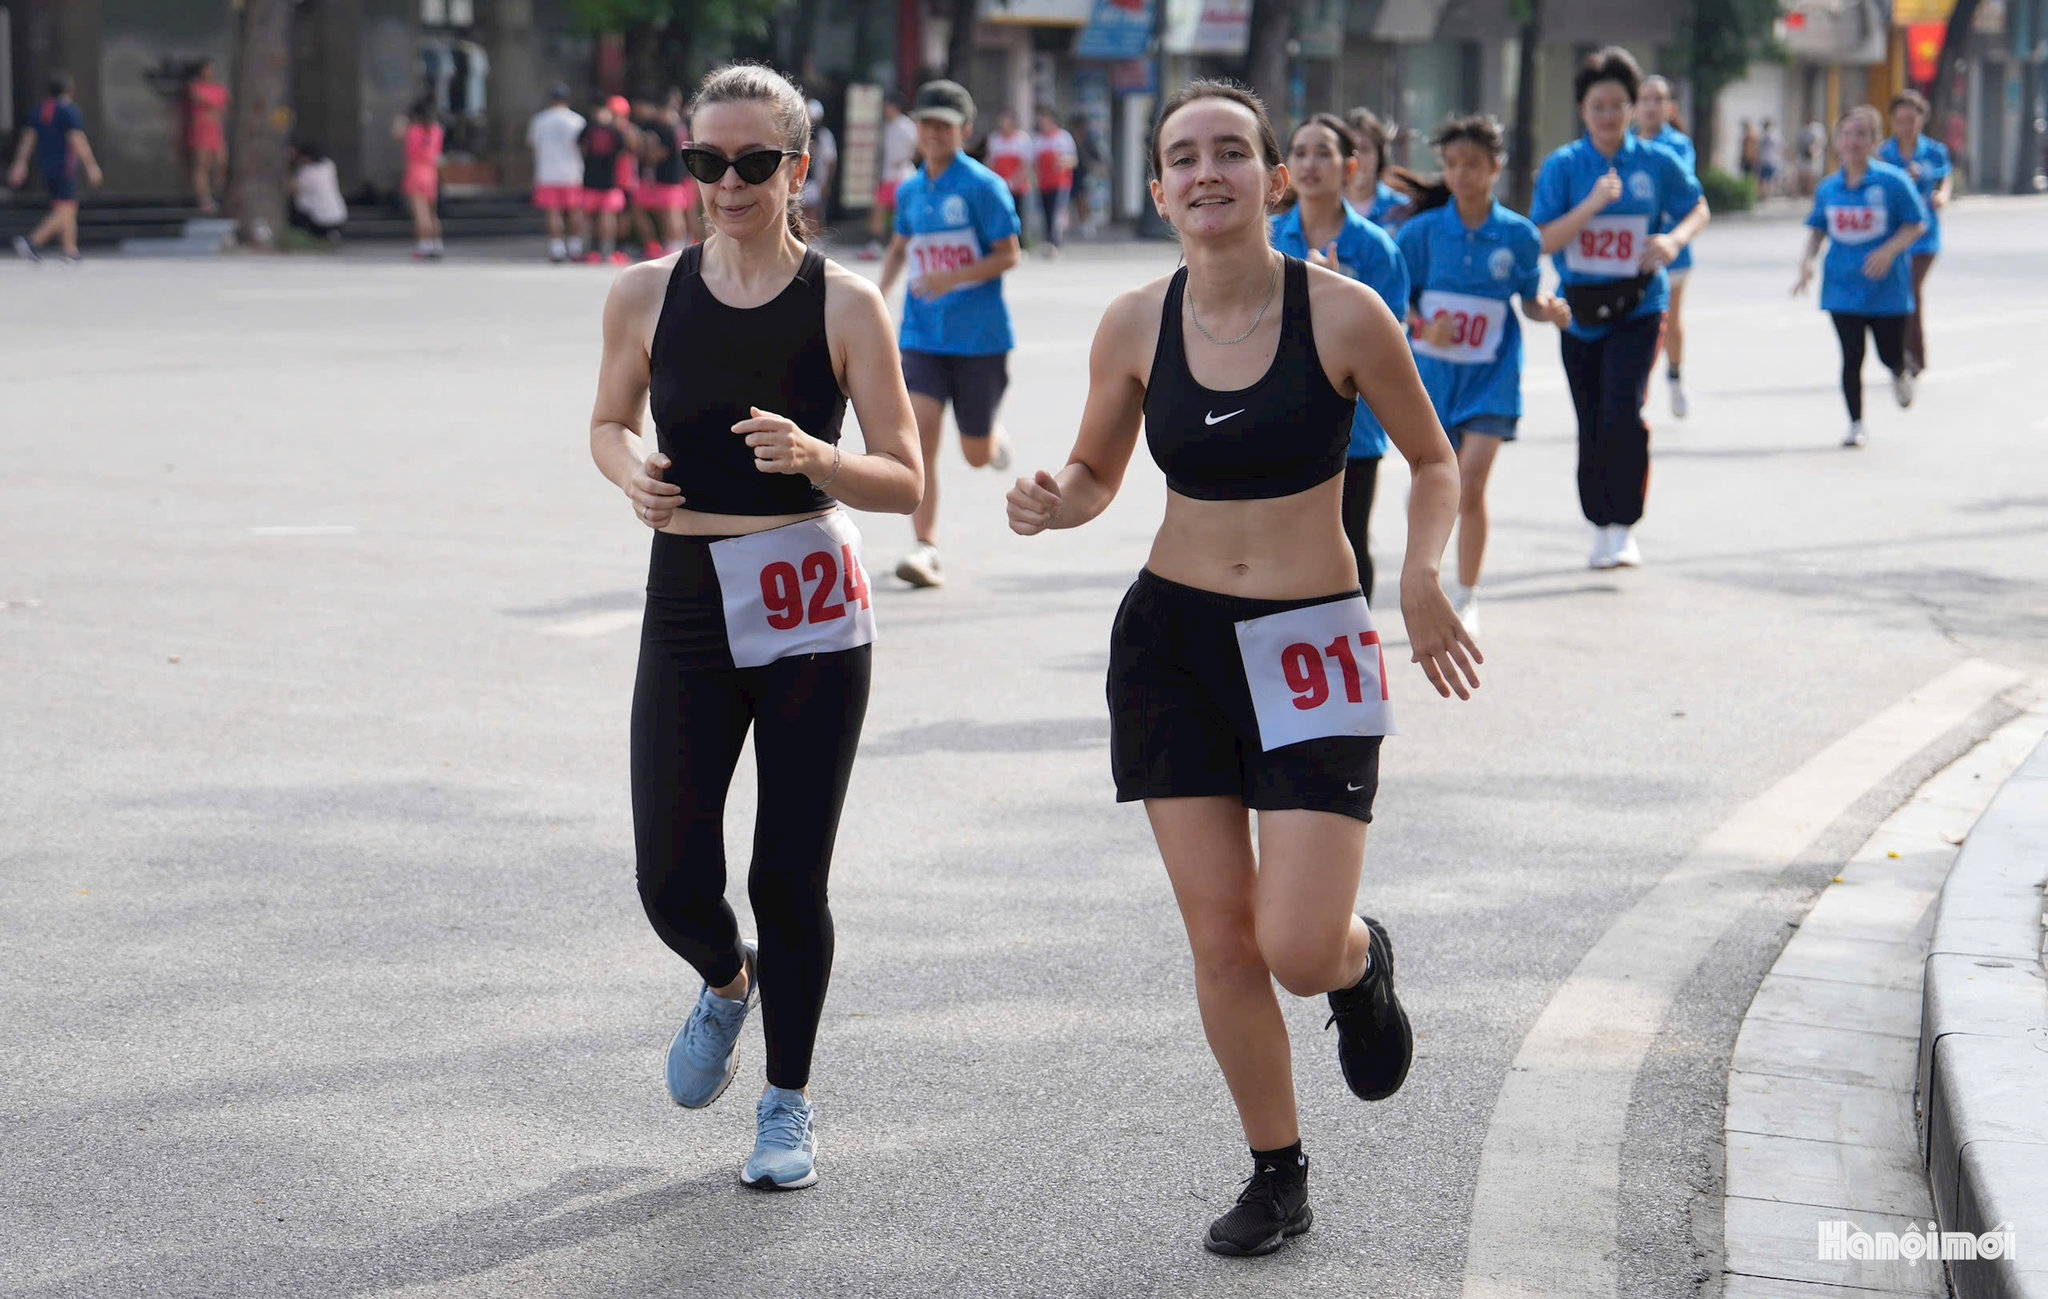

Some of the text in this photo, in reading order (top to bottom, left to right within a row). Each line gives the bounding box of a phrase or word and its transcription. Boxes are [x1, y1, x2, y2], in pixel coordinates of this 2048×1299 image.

[1580, 229, 1634, 260] 928
[760, 544, 869, 630] 924
[1281, 630, 1389, 711] 917
